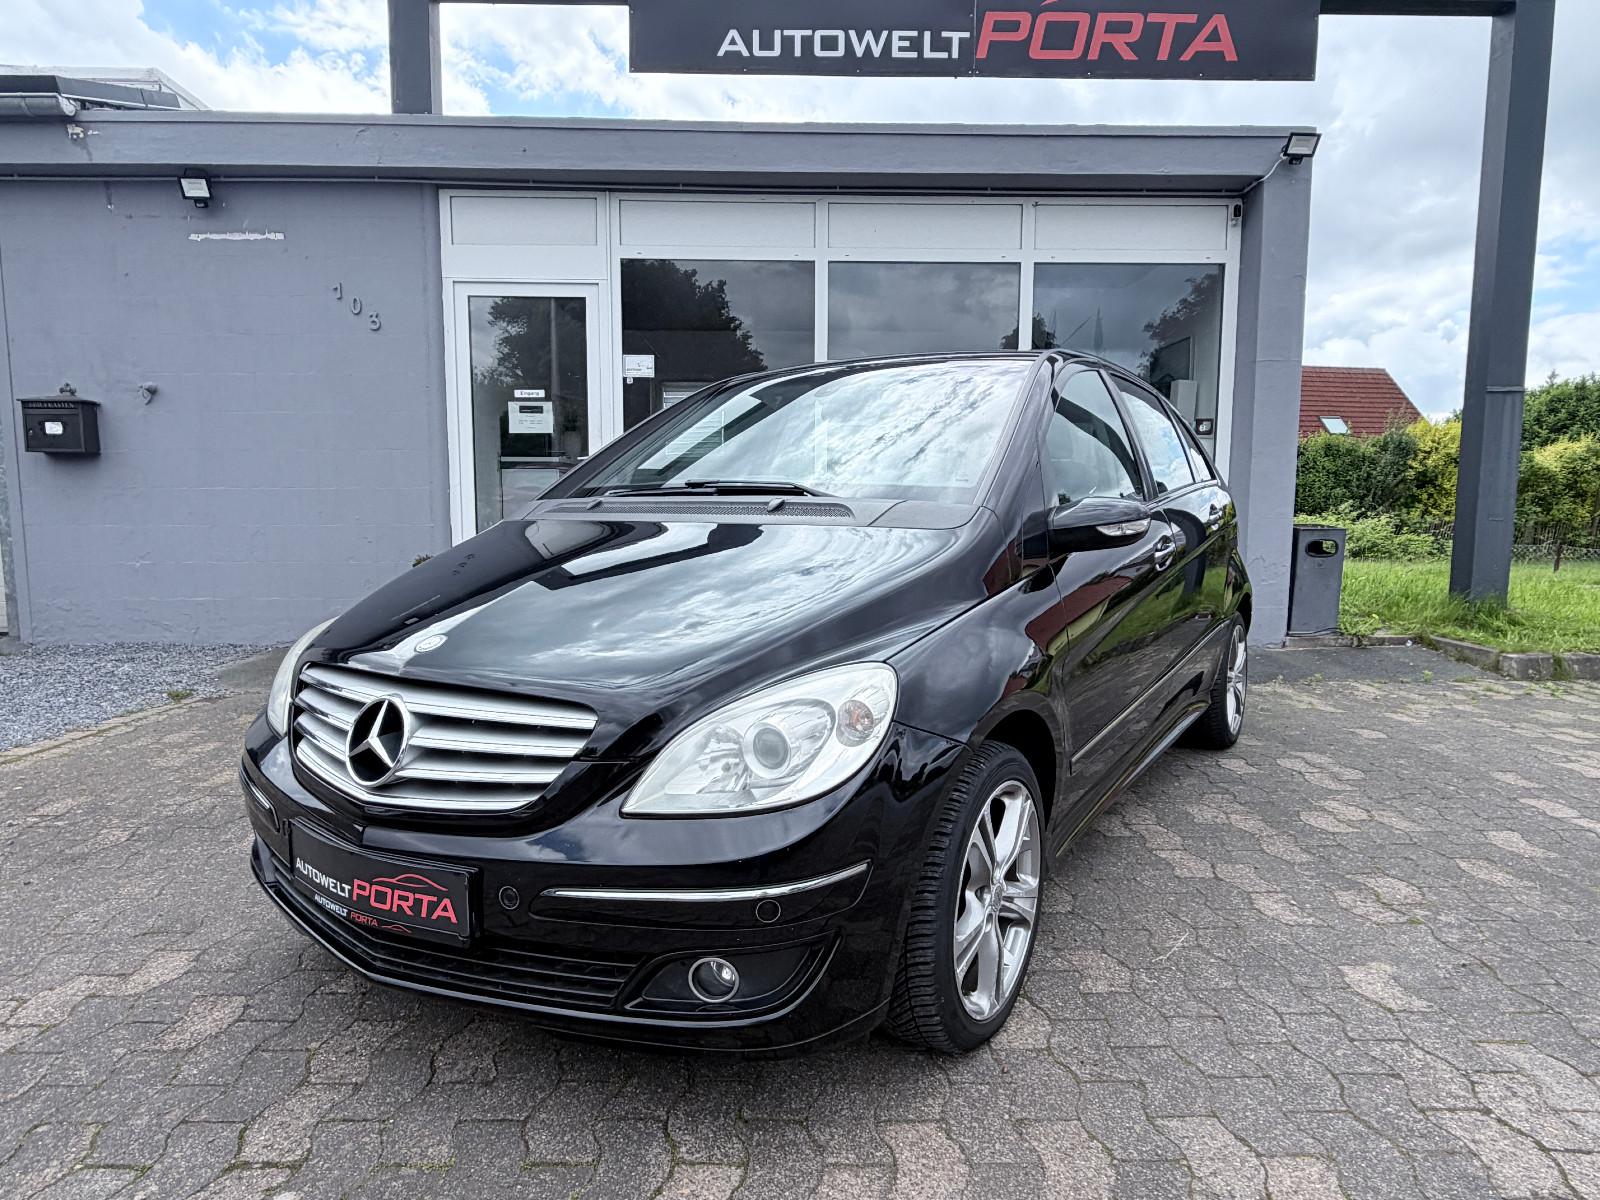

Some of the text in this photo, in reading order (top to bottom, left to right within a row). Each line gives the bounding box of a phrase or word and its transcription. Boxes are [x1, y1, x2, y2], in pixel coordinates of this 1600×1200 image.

[717, 11, 1238, 61] AUTOWELT PORTA
[296, 857, 458, 924] AUTOWELT PORTA
[314, 893, 379, 927] AUTOWELT PORTA
